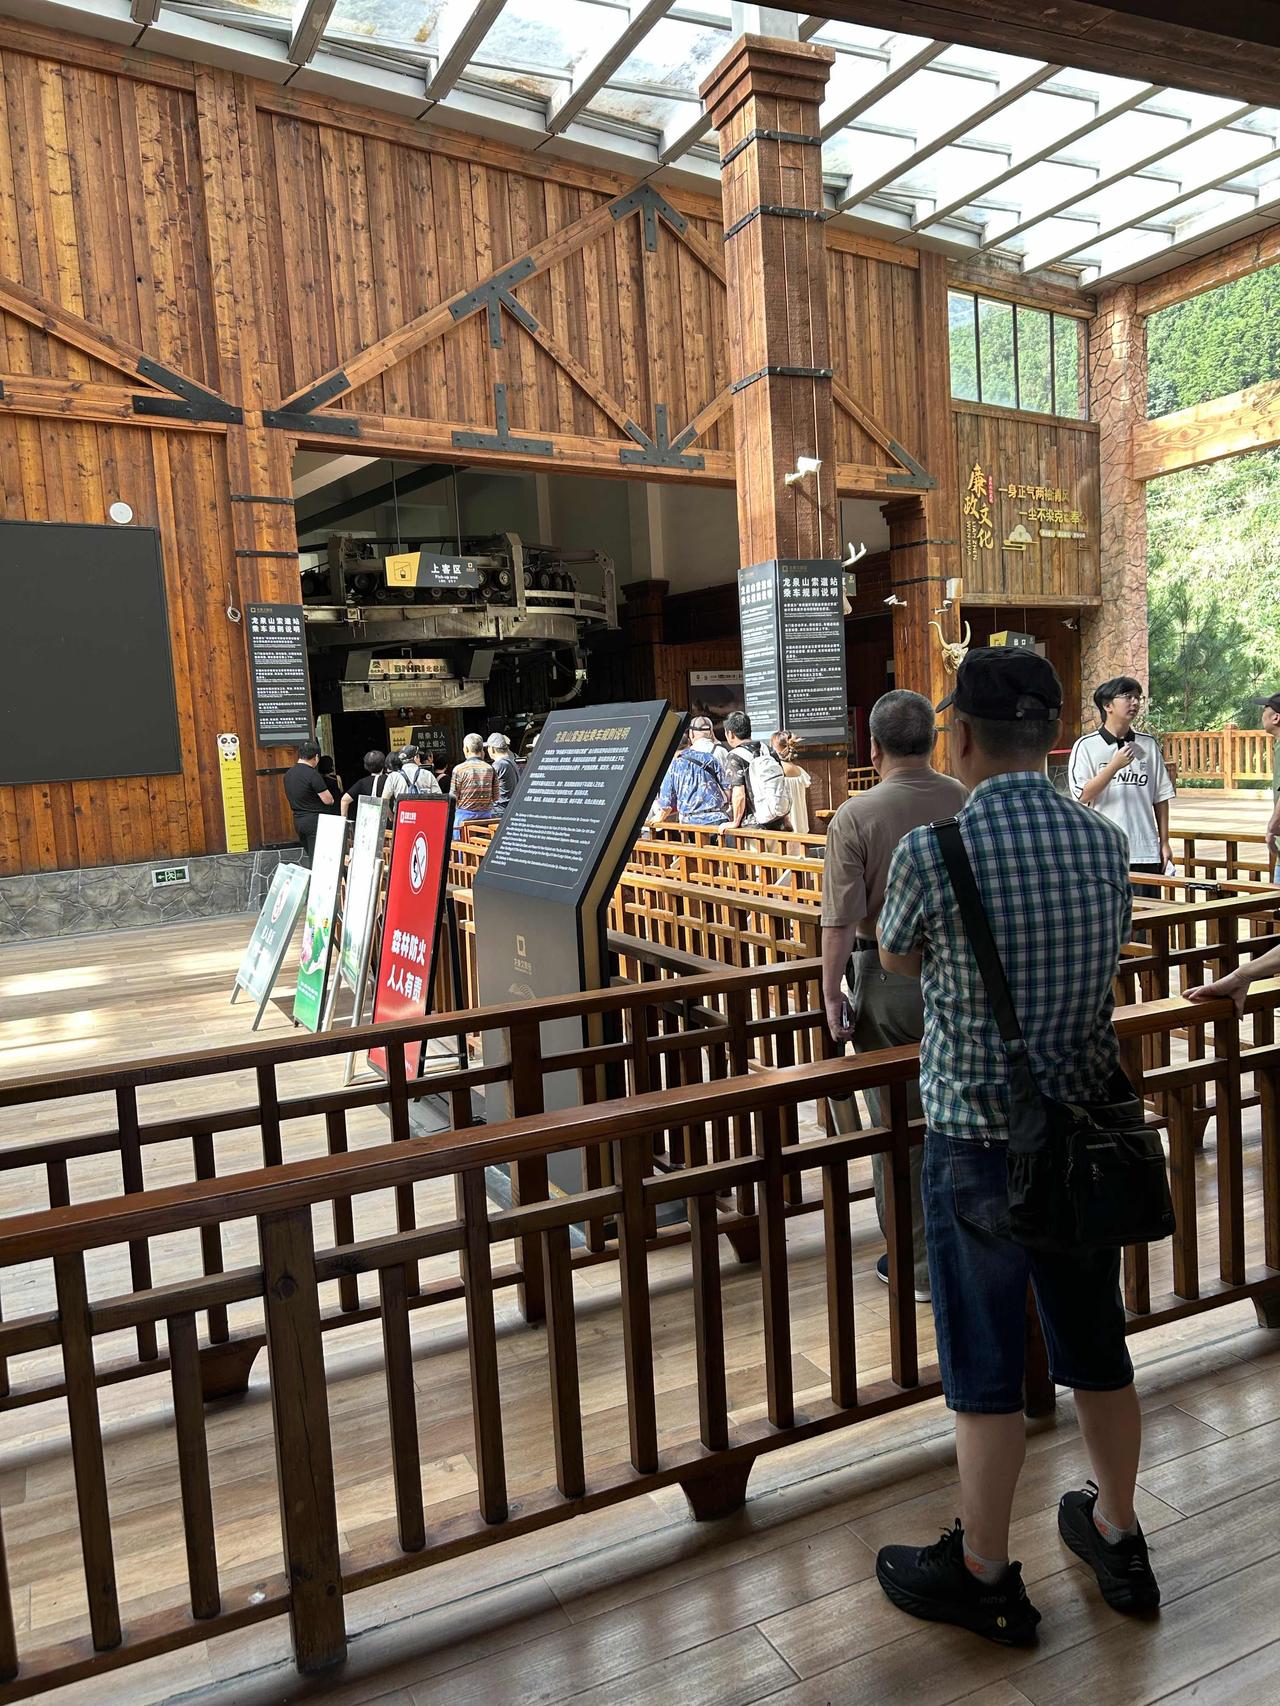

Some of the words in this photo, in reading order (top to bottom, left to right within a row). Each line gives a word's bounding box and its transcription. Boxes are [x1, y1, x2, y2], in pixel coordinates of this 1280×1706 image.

[963, 463, 994, 549] 廉政文化
[431, 563, 461, 574] 上客区
[782, 577, 838, 587] 龙泉山索道站
[783, 587, 839, 598] 乘车规则说明
[1112, 769, 1149, 786] -Ning
[391, 929, 427, 966] 森林防火
[387, 964, 423, 1003] 人人有责
